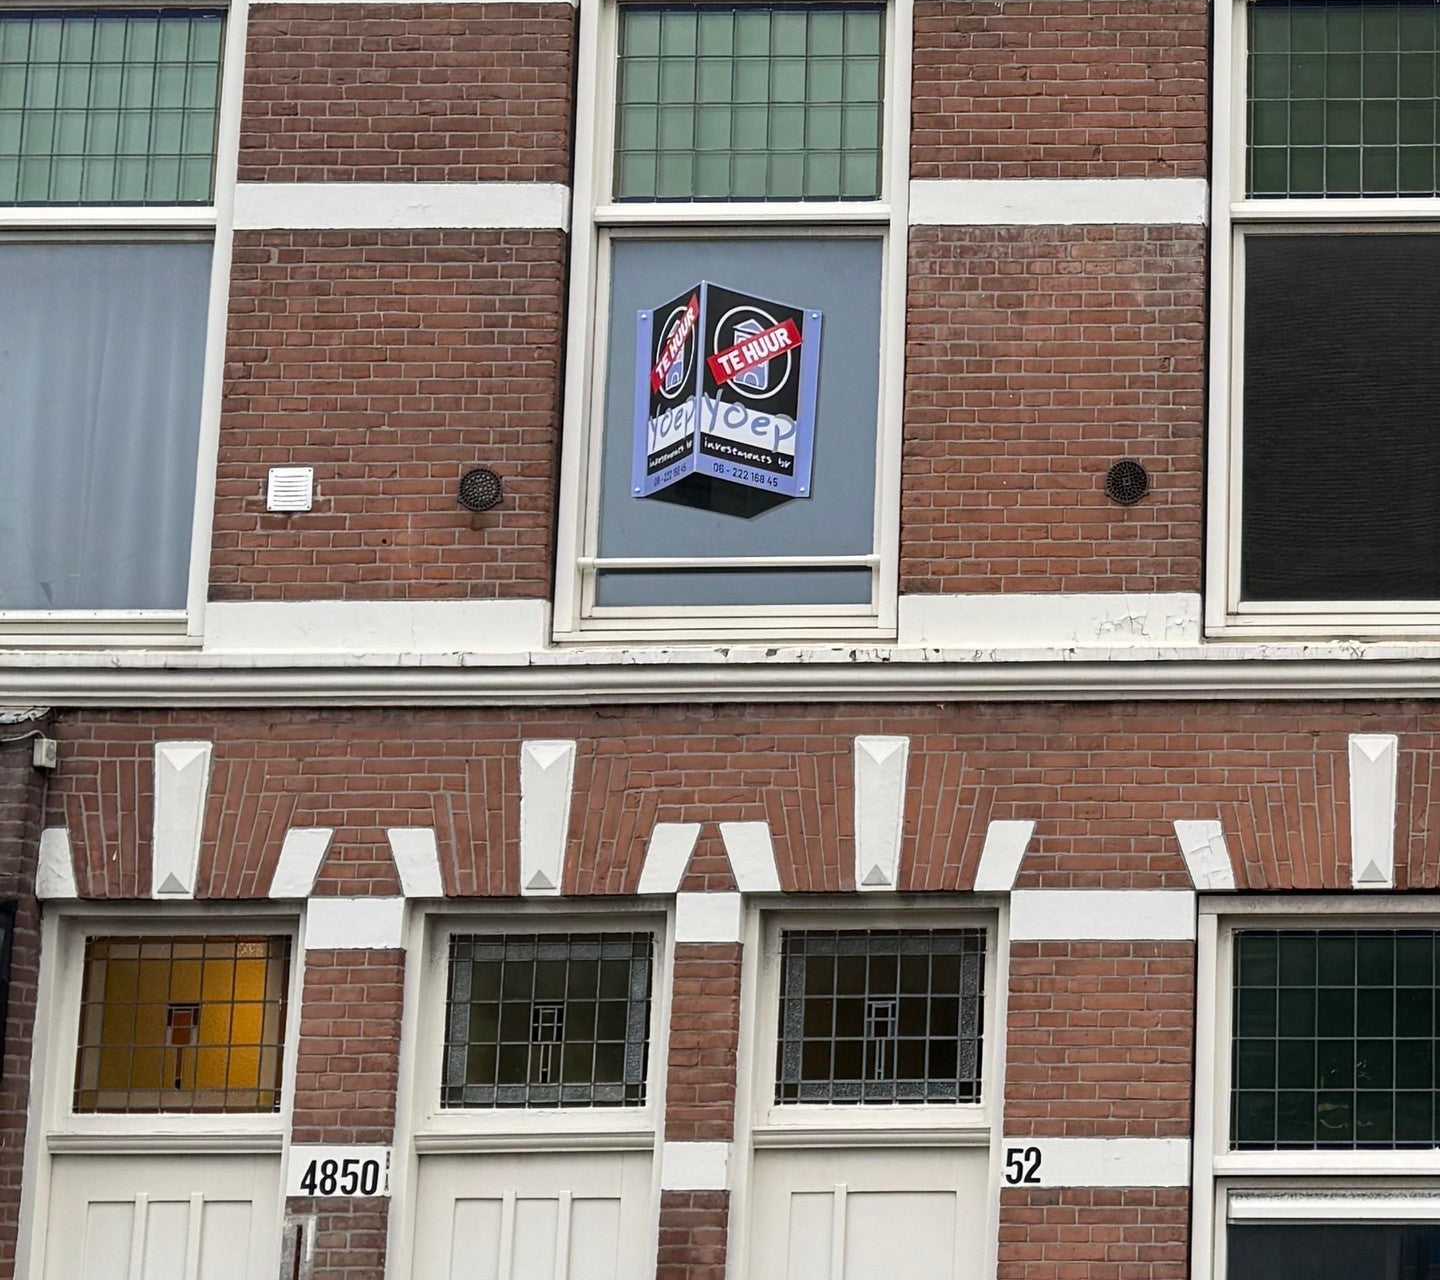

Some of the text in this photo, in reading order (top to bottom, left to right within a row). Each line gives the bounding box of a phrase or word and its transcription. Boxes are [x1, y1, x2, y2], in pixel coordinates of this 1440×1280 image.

[656, 307, 695, 379] TE HUUR
[717, 327, 792, 375] TE HUUR
[1005, 1146, 1042, 1184] 52
